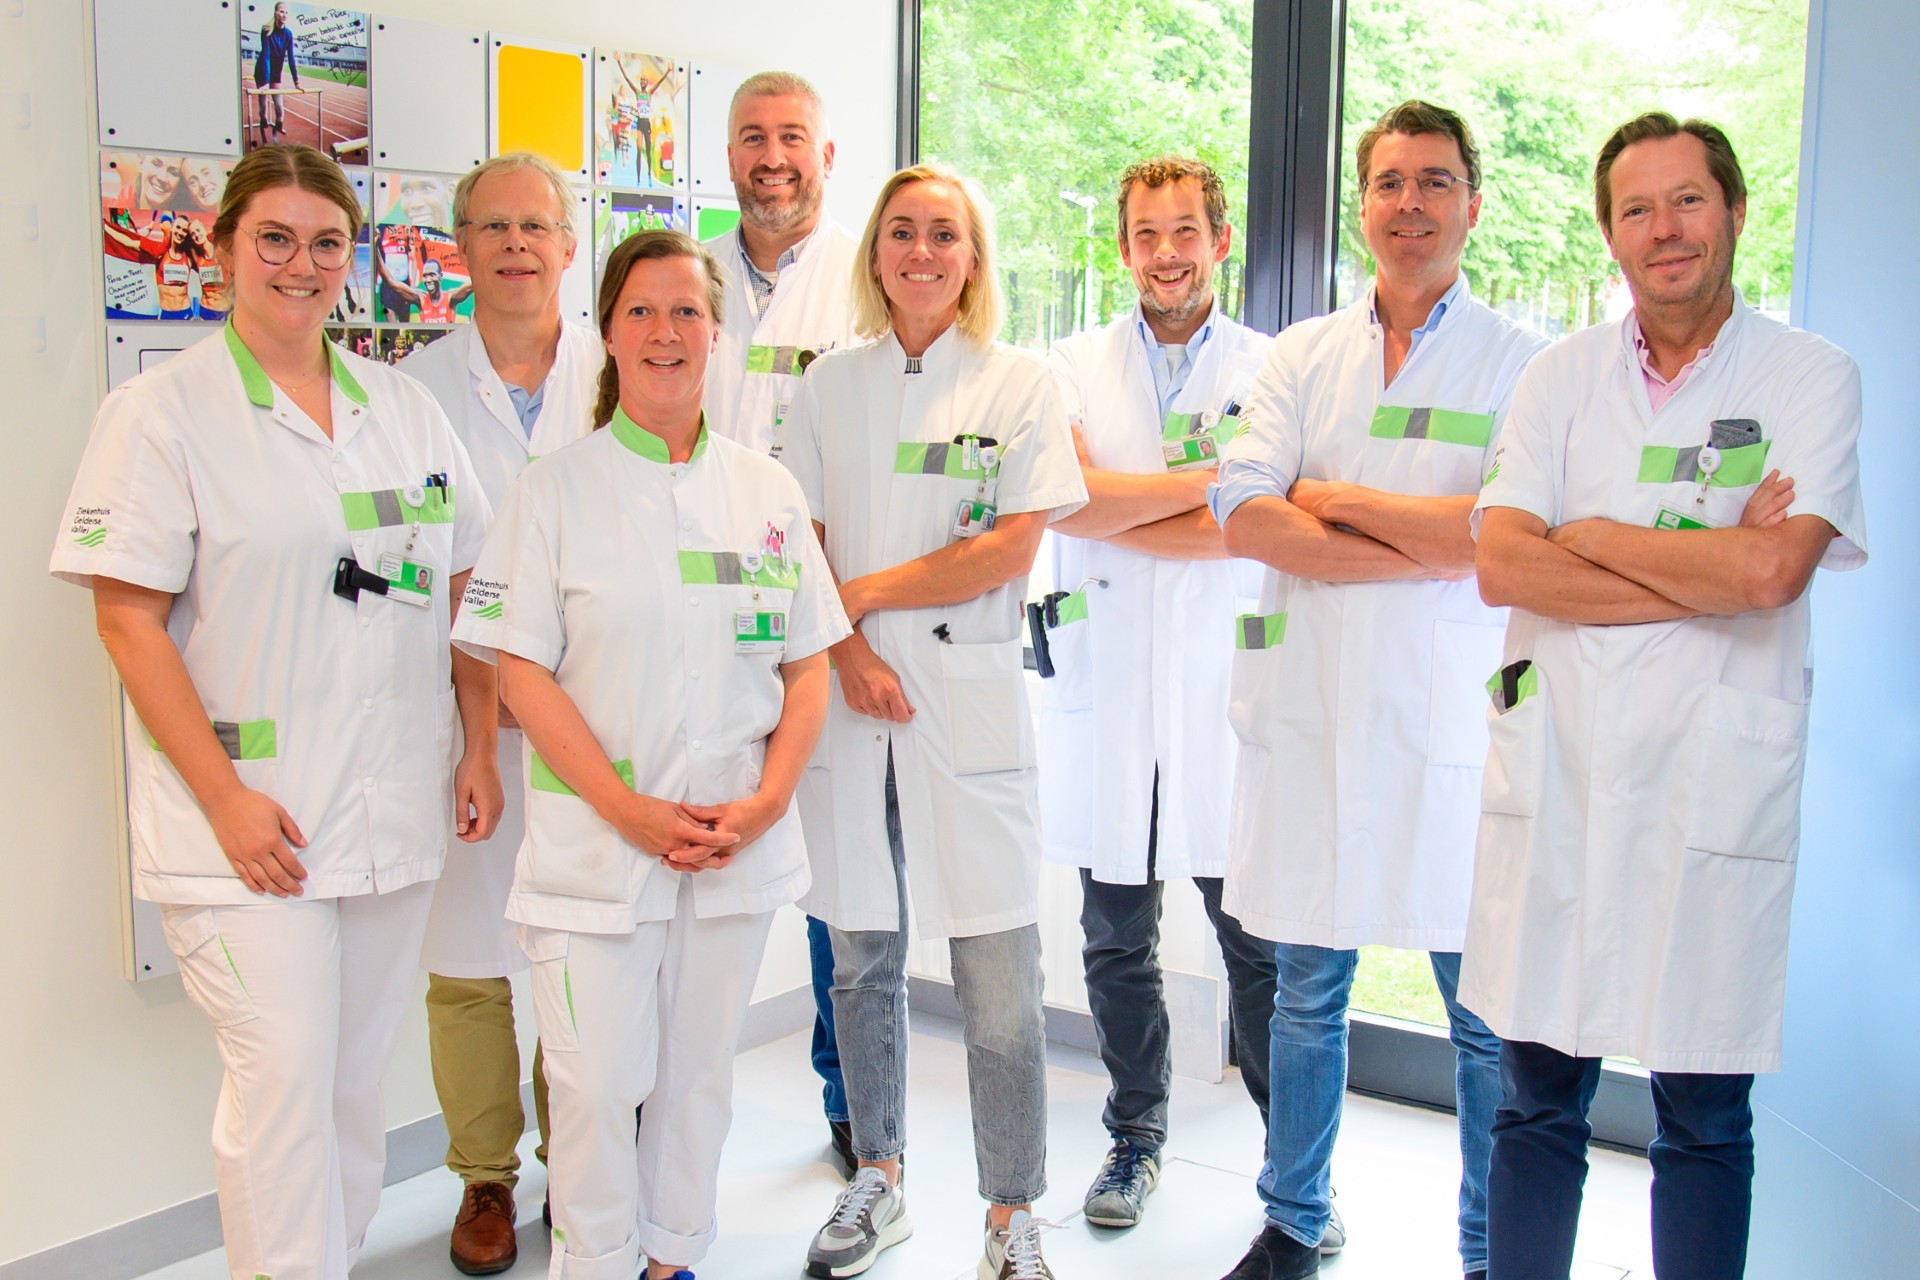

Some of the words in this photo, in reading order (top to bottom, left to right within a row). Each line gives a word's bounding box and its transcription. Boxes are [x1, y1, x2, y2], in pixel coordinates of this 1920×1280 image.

[76, 506, 111, 515] Ziekenhuis
[73, 516, 102, 525] Gelderse
[71, 525, 90, 534] Vallei
[468, 577, 509, 590] Ziekenhuis
[465, 586, 501, 599] Gelderse
[464, 596, 487, 607] Vallei
